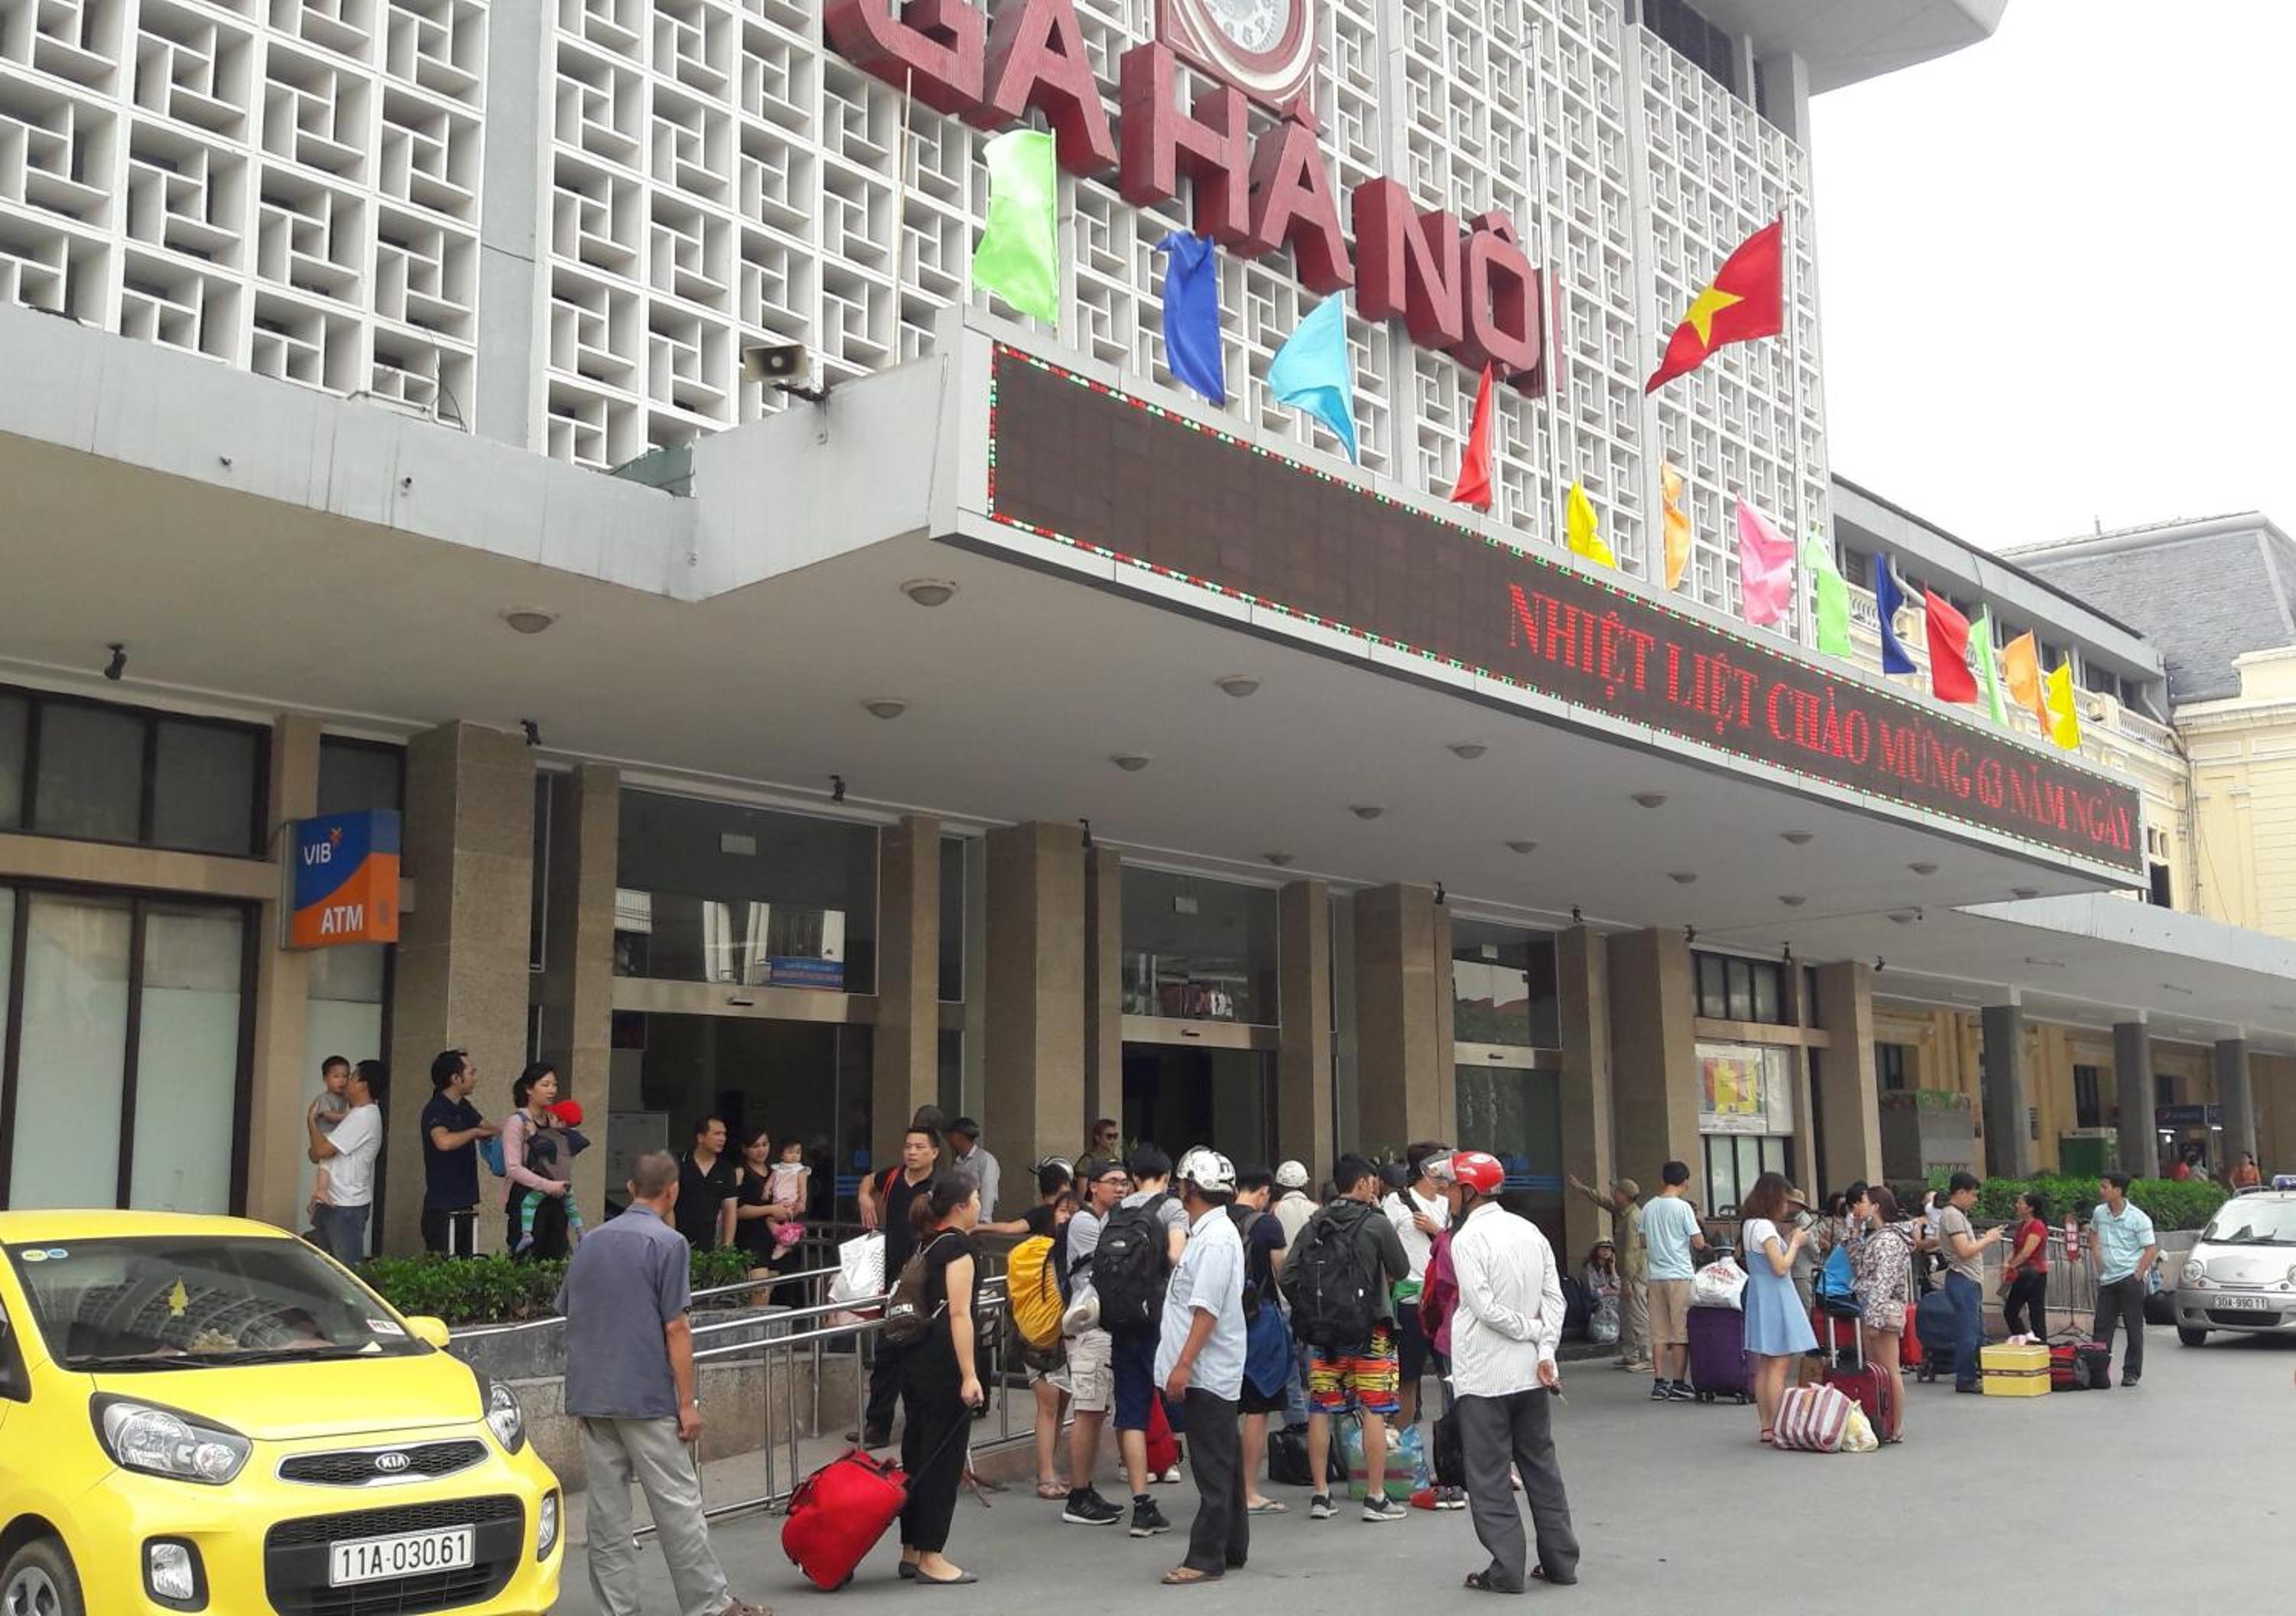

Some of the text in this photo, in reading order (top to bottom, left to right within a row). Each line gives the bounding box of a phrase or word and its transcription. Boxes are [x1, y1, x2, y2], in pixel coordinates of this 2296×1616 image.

[1120, 41, 1353, 295] HÀ
[1508, 582, 1656, 701] NHIỆT
[1665, 642, 1759, 735] LIỆT
[1766, 683, 1870, 764] CHÀO
[1975, 758, 2003, 809] 63
[304, 842, 331, 865] VIB
[321, 904, 364, 935] ATM
[382, 1455, 406, 1468] KIA
[343, 1533, 465, 1578] 11A-030.61
